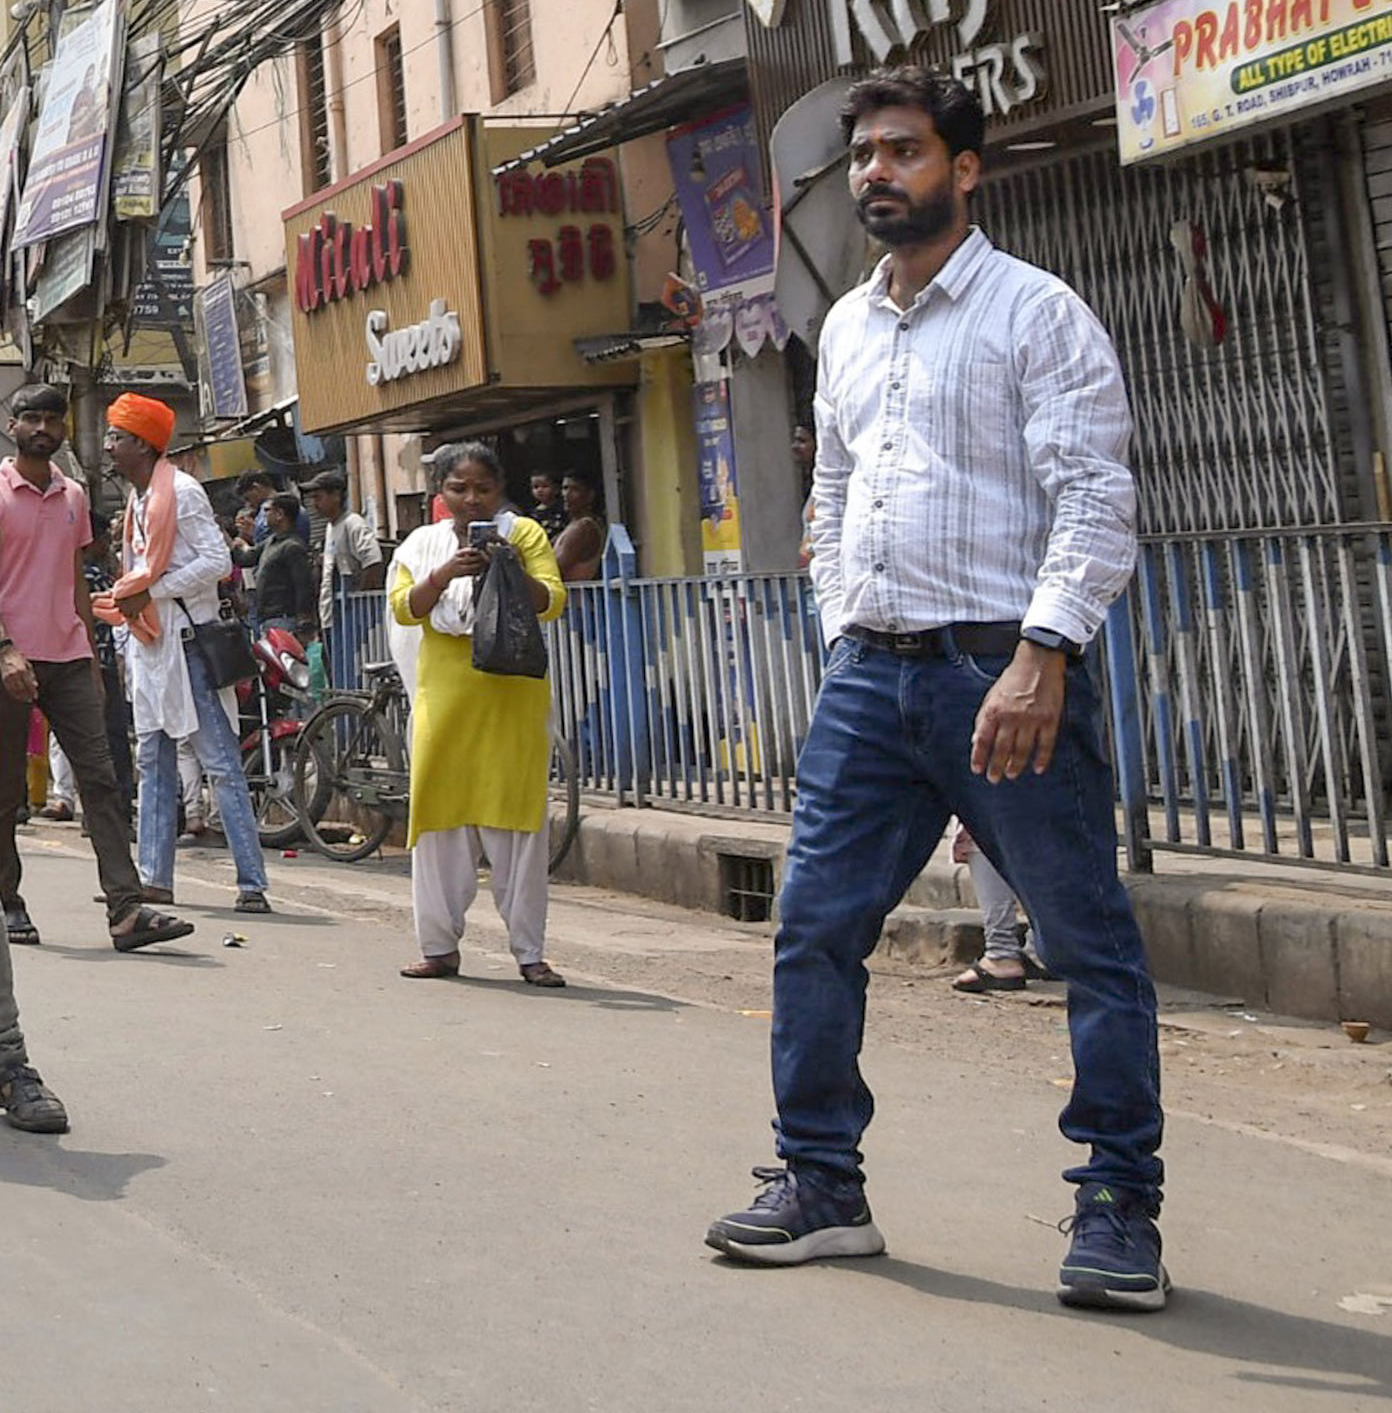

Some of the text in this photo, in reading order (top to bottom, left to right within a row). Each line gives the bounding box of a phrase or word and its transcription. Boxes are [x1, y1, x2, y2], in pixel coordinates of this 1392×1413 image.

[952, 34, 1038, 116] ERS
[1238, 63, 1265, 89] ALL
[1267, 48, 1305, 78] TYPE
[1306, 39, 1327, 65] OF
[1322, 56, 1371, 85] HOWRAH
[366, 297, 462, 386] Sweets
